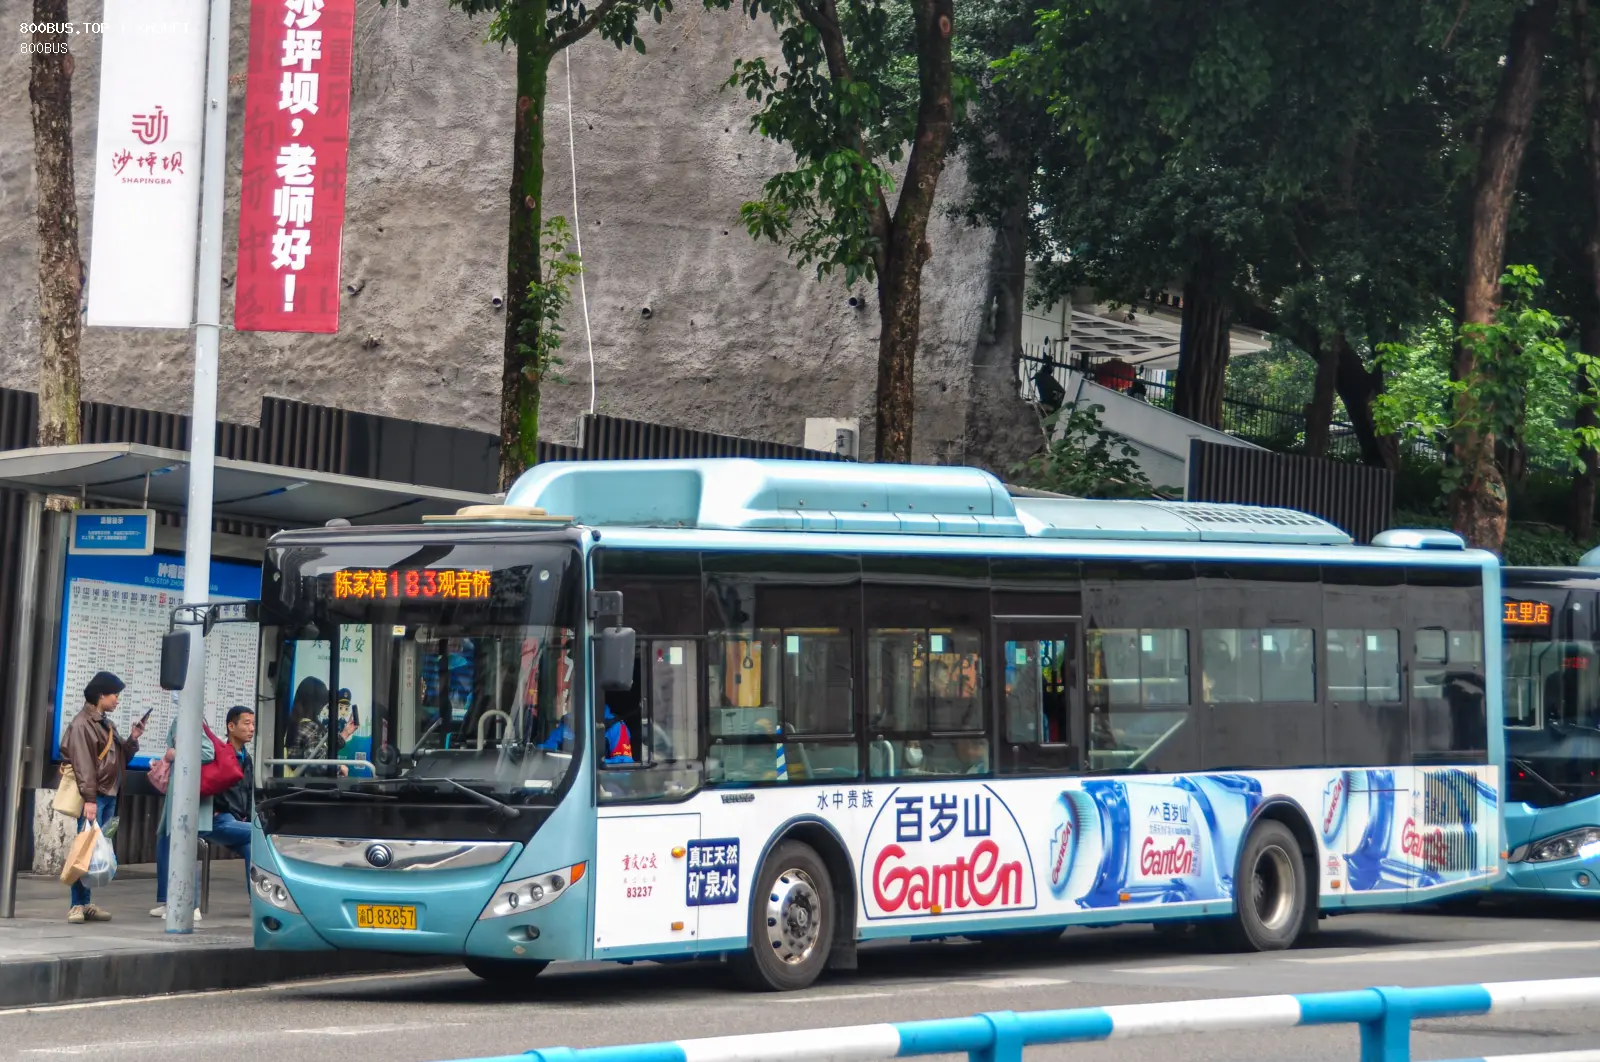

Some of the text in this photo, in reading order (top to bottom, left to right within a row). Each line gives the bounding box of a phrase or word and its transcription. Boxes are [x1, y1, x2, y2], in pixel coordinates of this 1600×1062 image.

[112, 148, 184, 176] 沙坪坝
[1503, 602, 1549, 624] 五里店
[817, 790, 874, 810] 水中贵族
[895, 793, 991, 843] 百岁山
[1162, 802, 1188, 823] 百岁山
[688, 844, 738, 868] 真正天然
[688, 869, 737, 900] 矿泉水
[872, 839, 1023, 913] Ganten
[626, 885, 653, 898] 83237
